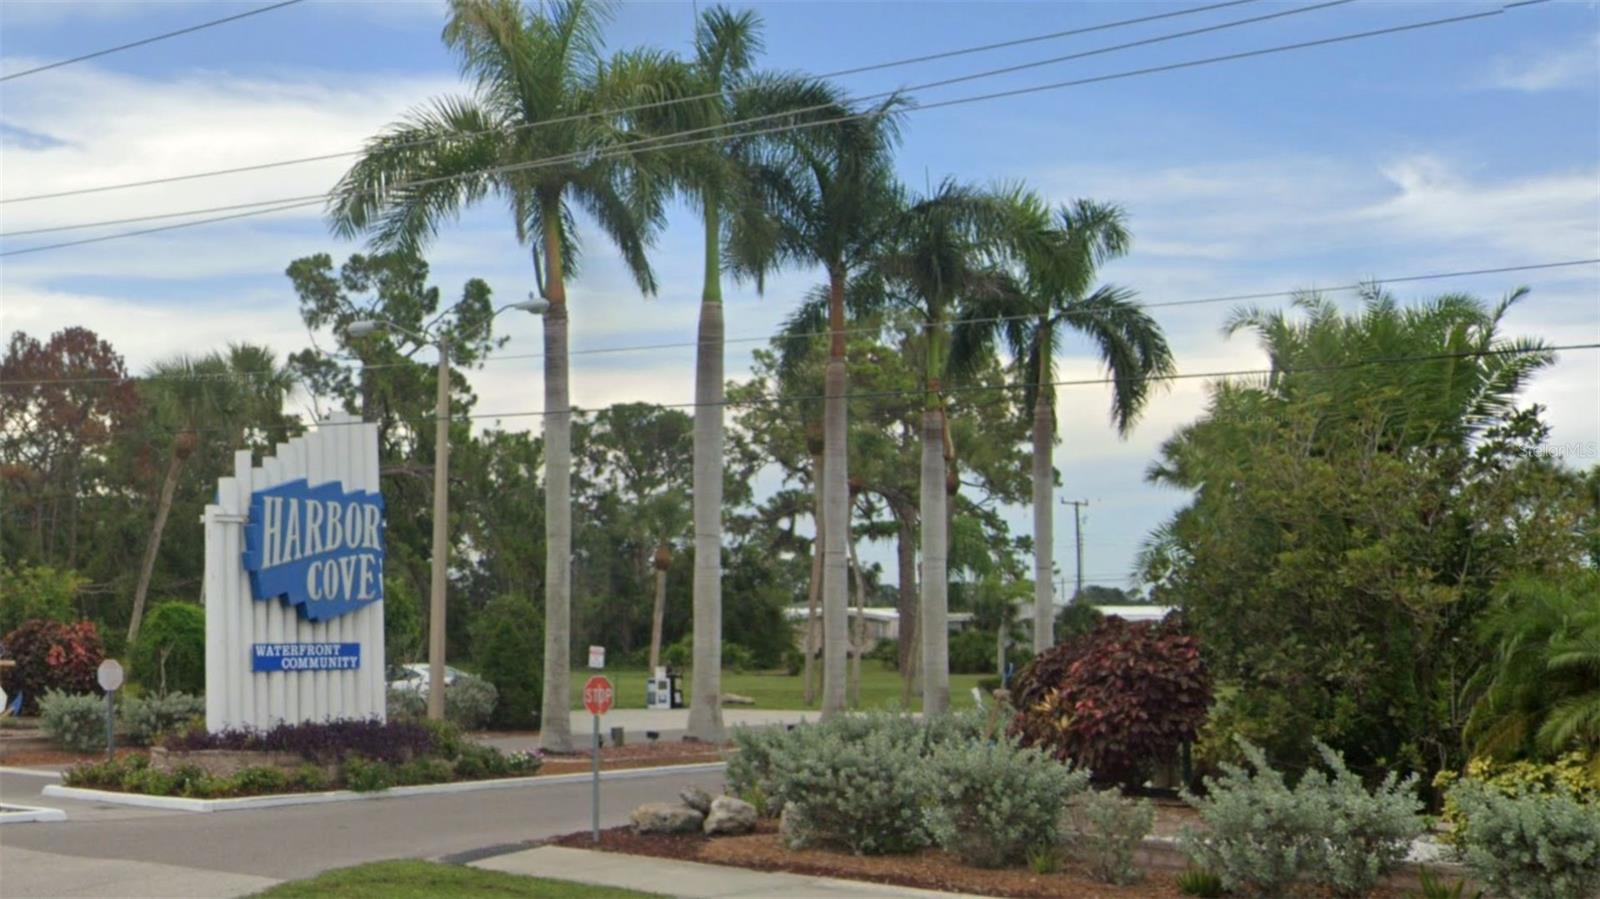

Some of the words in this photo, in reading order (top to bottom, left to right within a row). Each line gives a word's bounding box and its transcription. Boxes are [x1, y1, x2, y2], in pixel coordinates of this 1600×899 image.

[262, 496, 381, 569] HARBOR
[306, 554, 376, 601] COVE
[255, 644, 341, 657] WATERFRONT
[281, 656, 359, 669] COMMUNITY
[584, 687, 612, 704] STOP
